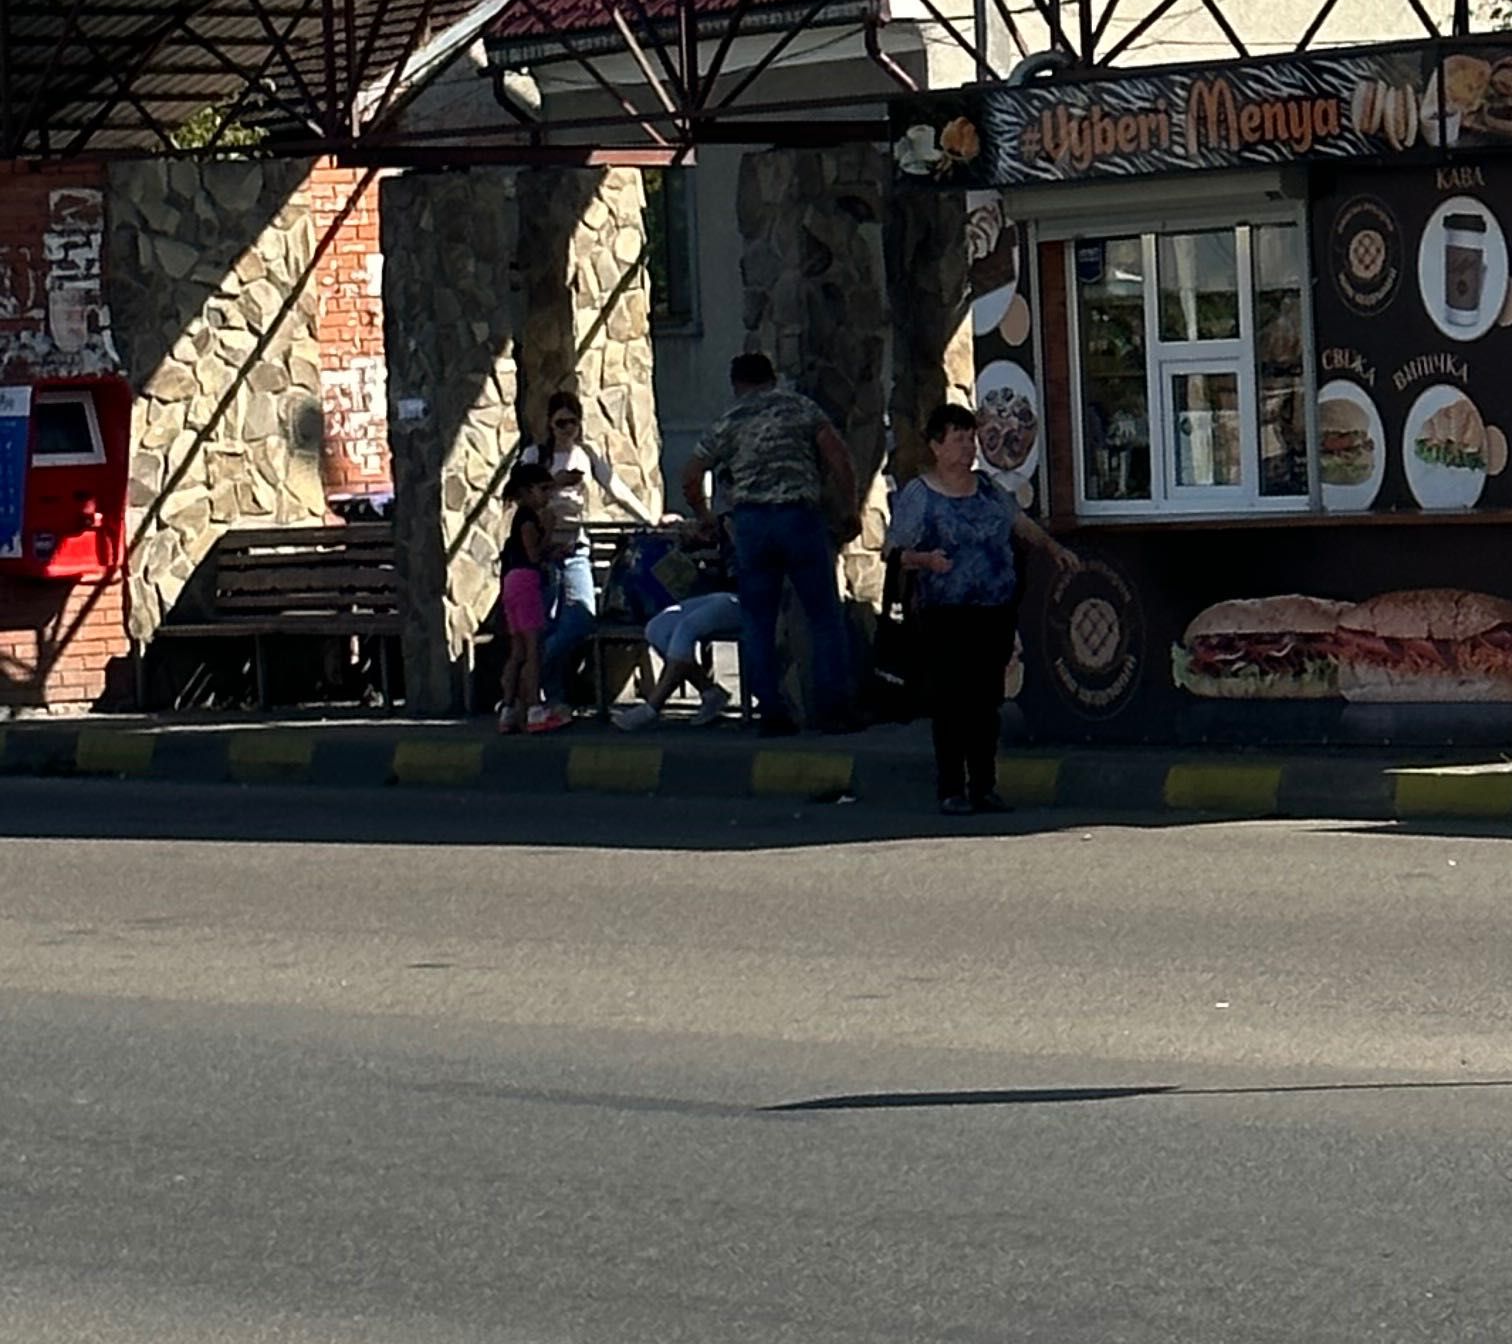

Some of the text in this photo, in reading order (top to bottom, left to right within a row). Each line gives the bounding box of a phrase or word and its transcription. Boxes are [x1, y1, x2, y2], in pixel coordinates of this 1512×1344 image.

[1020, 77, 1341, 170] #Vyberi Menya
[1436, 166, 1486, 190] КАВА
[1321, 347, 1377, 387] СВІЖА
[1392, 352, 1468, 392] ВИПІЧКА
